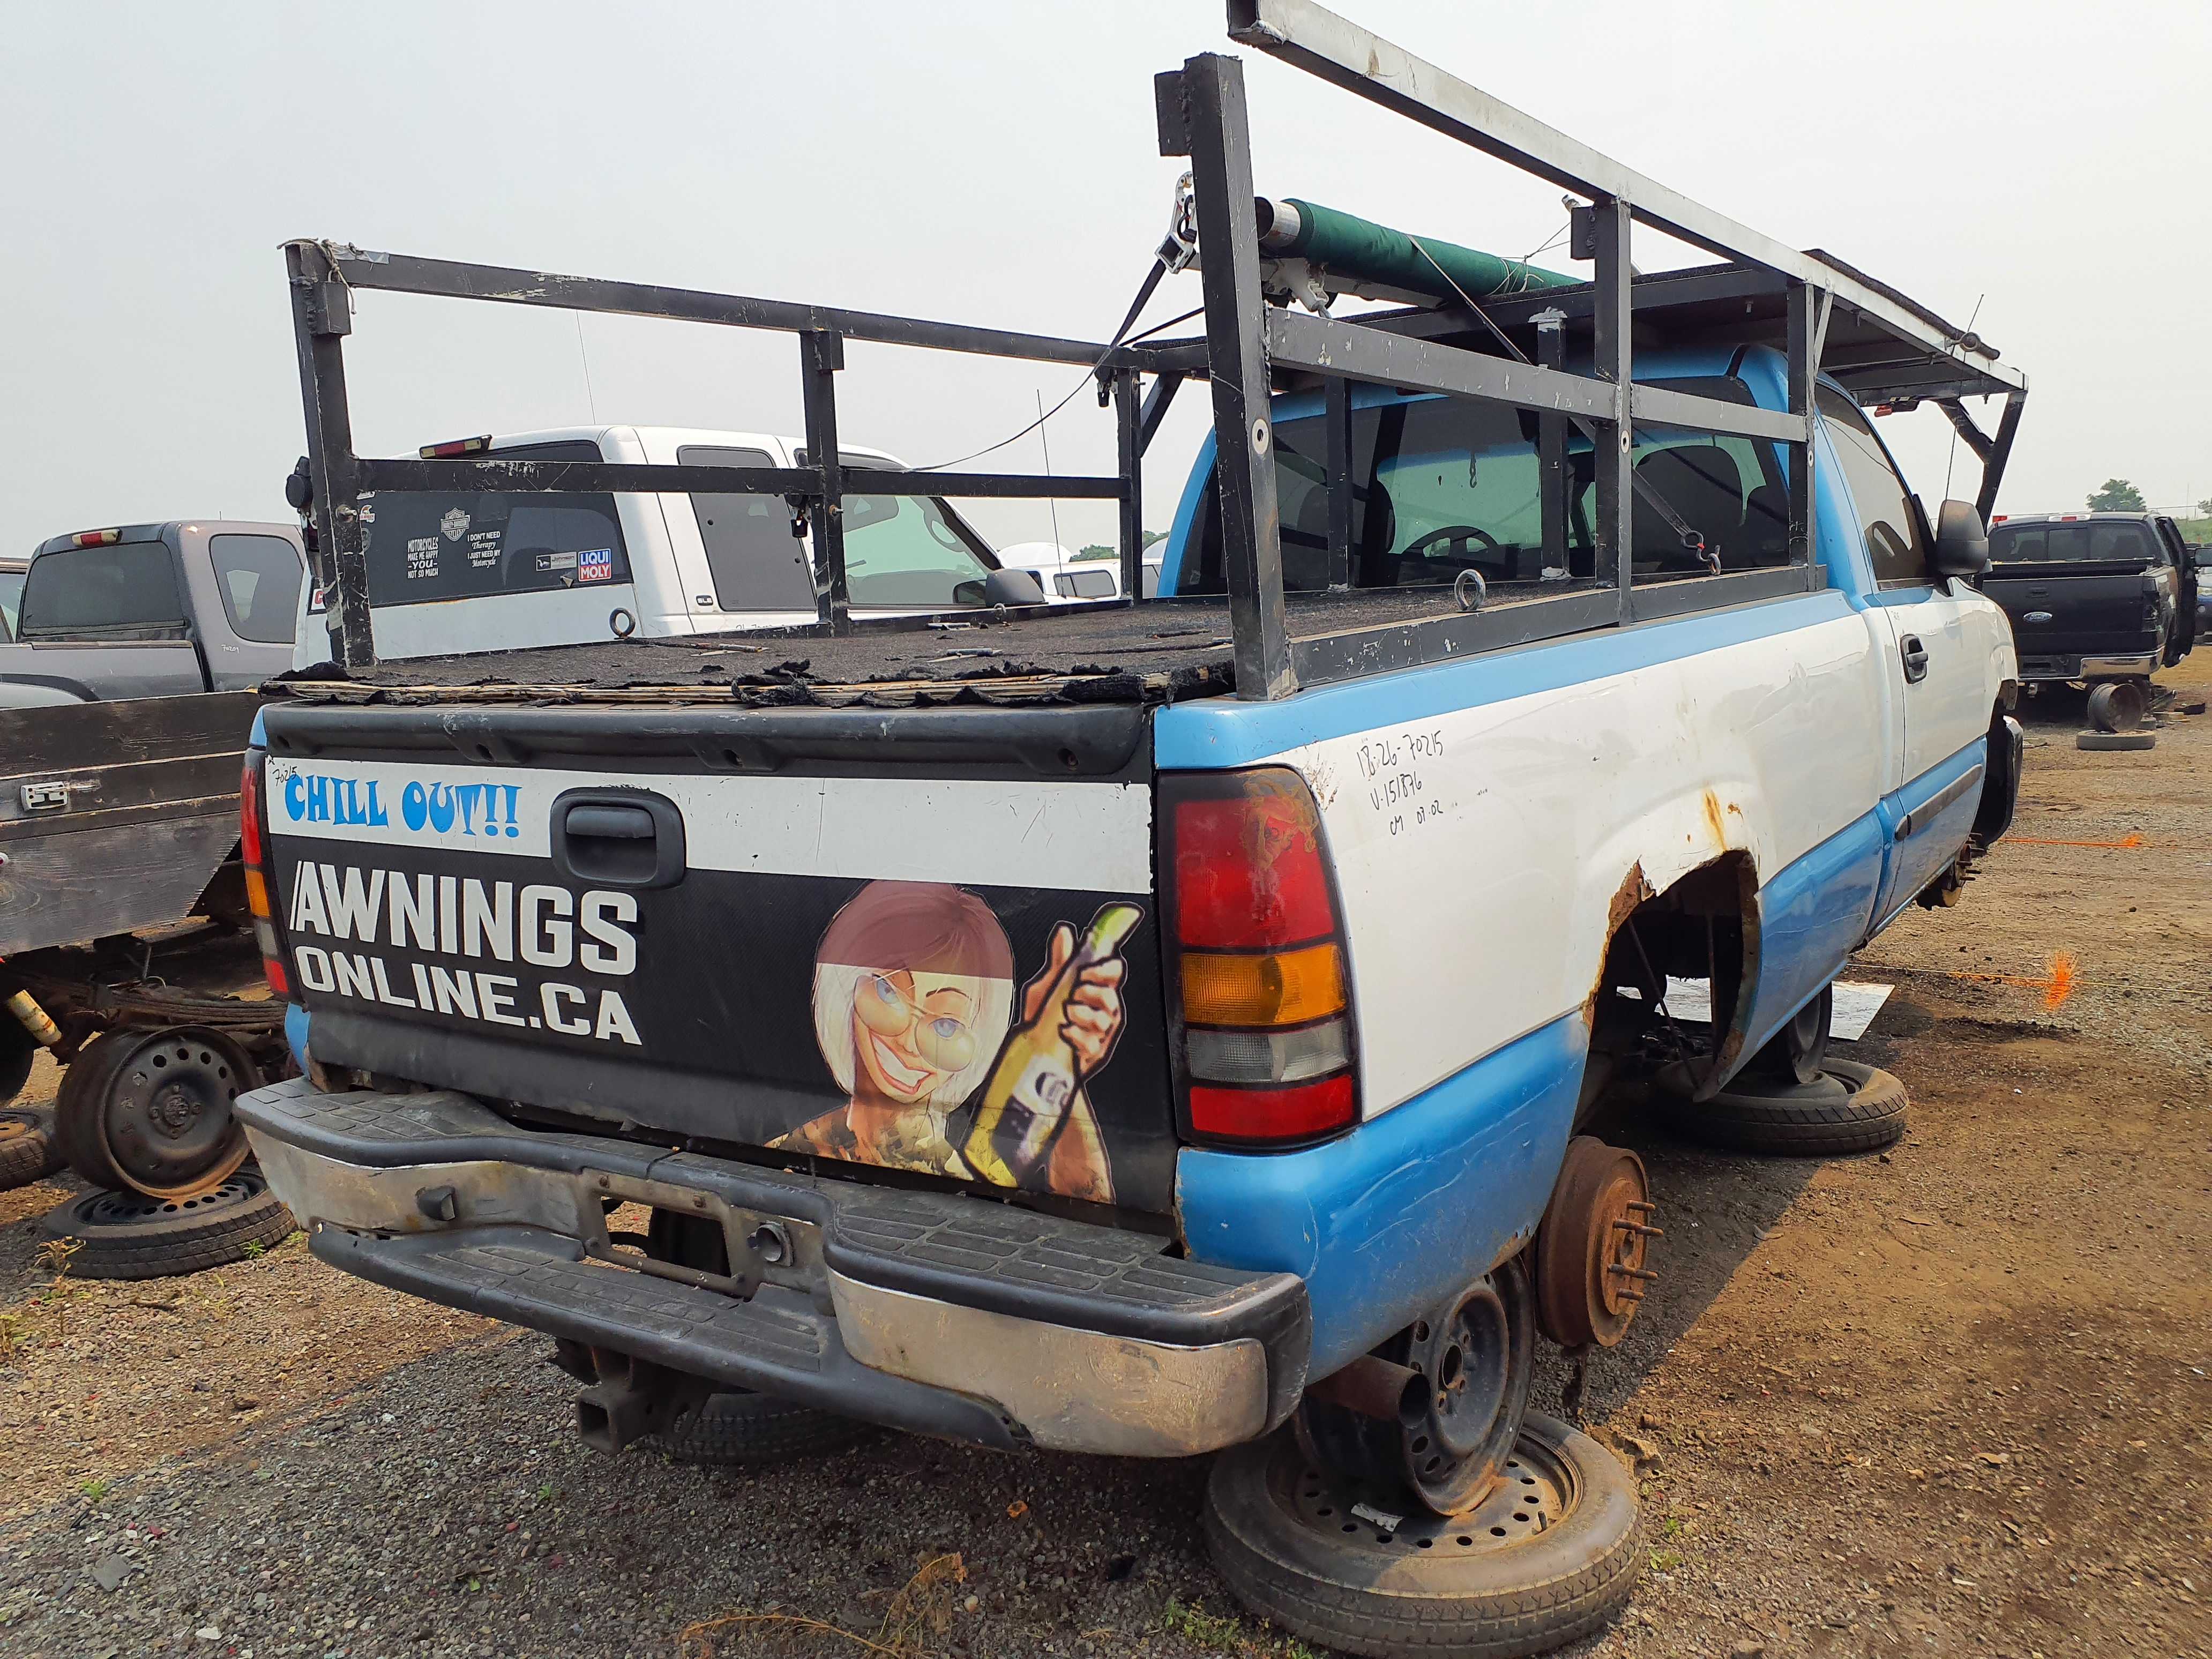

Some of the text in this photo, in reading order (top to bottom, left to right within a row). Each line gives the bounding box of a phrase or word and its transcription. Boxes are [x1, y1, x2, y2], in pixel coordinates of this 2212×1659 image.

[487, 531, 500, 540] NEED
[408, 537, 438, 552] MOTORCYCLES
[472, 541, 496, 550] Therapy
[408, 550, 438, 562] MAKE ME HAPPY
[472, 556, 496, 569] Motorcycle
[580, 551, 609, 565] LIQUI
[408, 567, 438, 579] NOT SO MUCH
[581, 565, 609, 579] MOLY
[285, 774, 522, 838] CHILL OUT!!
[289, 860, 638, 976] AWNINGS
[295, 946, 642, 1045] ONLINE.CA
